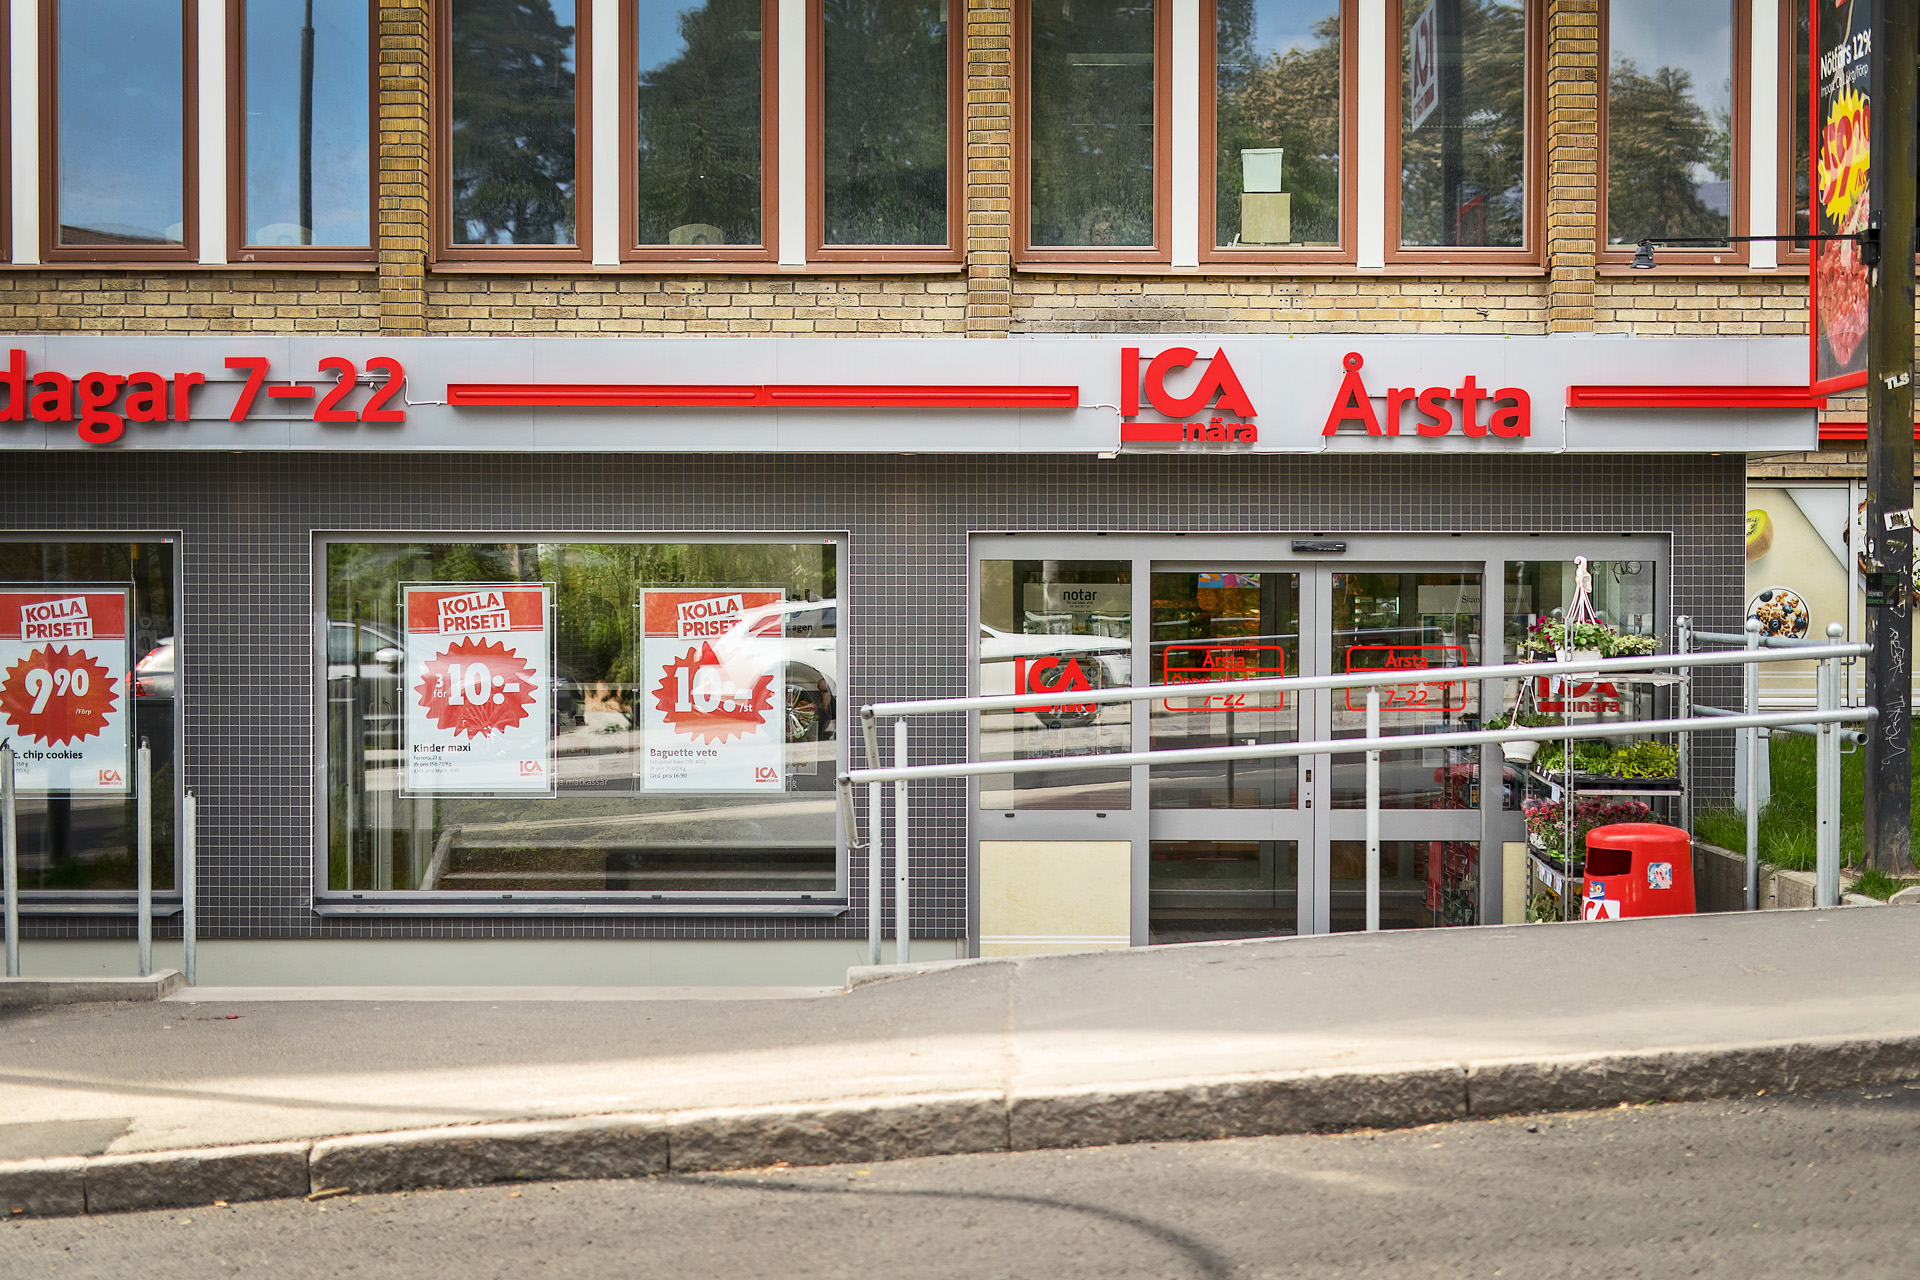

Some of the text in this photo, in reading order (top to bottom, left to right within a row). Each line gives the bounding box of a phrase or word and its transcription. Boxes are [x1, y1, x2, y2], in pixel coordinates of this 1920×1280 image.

[1820, 43, 1851, 80] Nötfärs
[1121, 347, 1258, 417] ICA
[1884, 372, 1910, 390] TLS
[0, 349, 205, 443] dagar
[1322, 352, 1531, 437] Årsta
[1186, 417, 1258, 443] nära
[1063, 589, 1098, 600] notar
[26, 601, 83, 622] KOLLA
[442, 593, 500, 615] KOLLA
[682, 599, 739, 620] KOLLA
[26, 622, 88, 638] PRISET!
[443, 614, 506, 632] PRISET!
[683, 619, 742, 637] PRISE
[1202, 649, 1245, 667] Årsta
[1385, 650, 1428, 667] Årsta
[435, 674, 444, 688] 3
[1014, 656, 1092, 695] ICA
[433, 689, 447, 698] för
[739, 704, 753, 713] /st
[1577, 697, 1620, 712] nära
[23, 750, 44, 761] chip
[46, 750, 83, 759] cookies
[413, 743, 471, 753] Kinder maxi
[650, 748, 718, 759] Baguette vete
[519, 760, 542, 772] ICA
[756, 767, 777, 779] ICA
[99, 769, 122, 781] ICA
